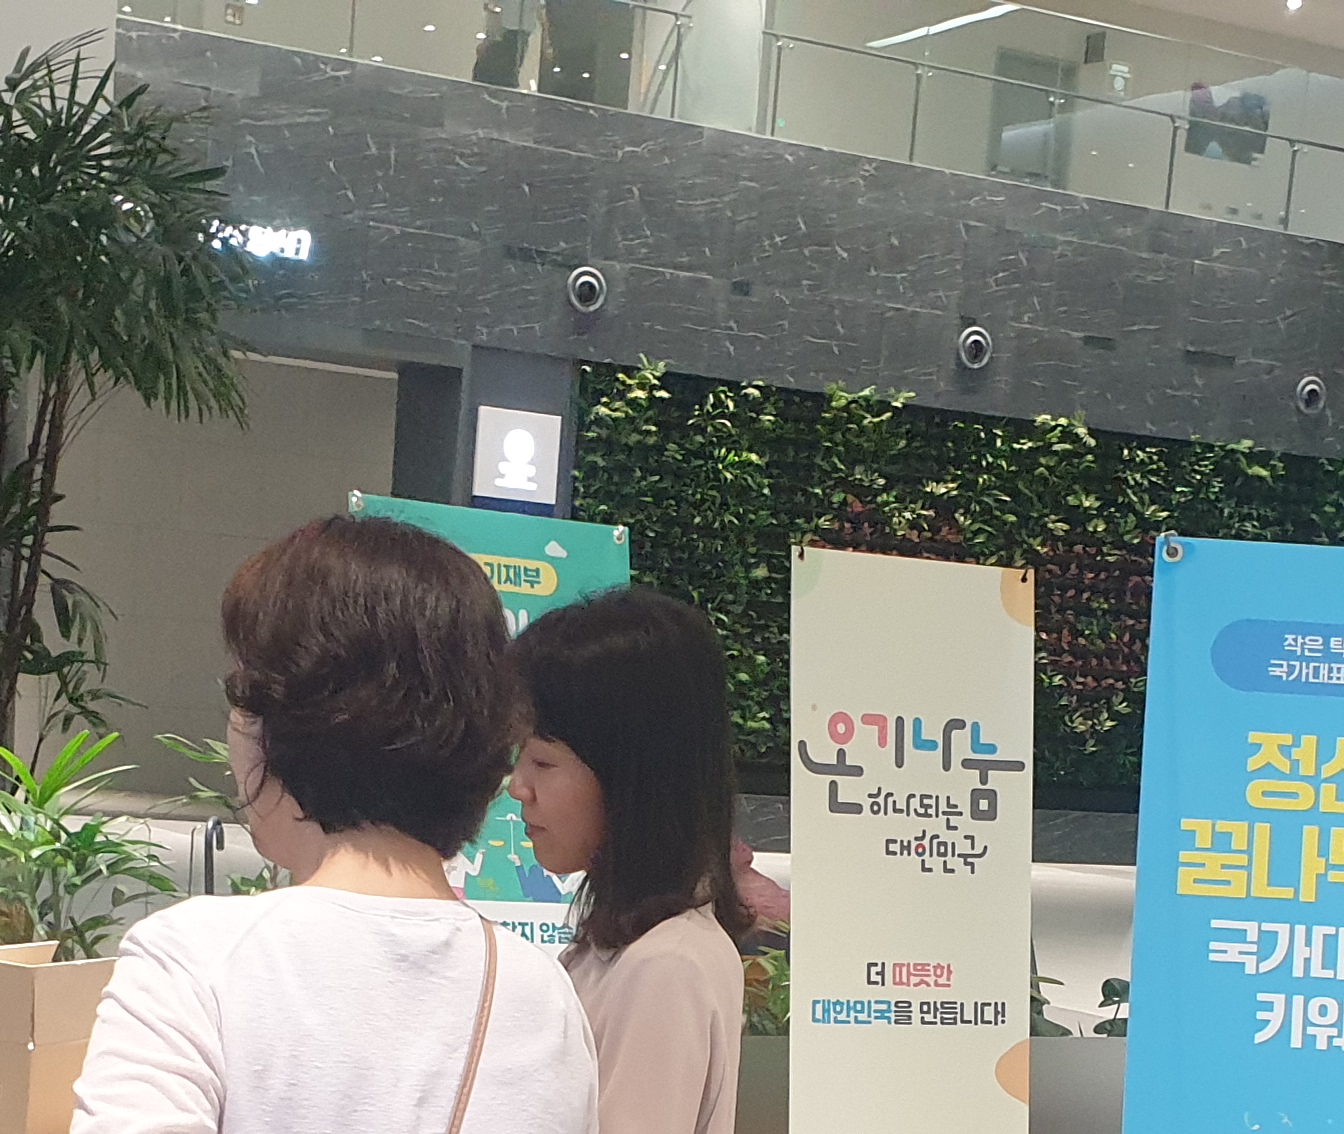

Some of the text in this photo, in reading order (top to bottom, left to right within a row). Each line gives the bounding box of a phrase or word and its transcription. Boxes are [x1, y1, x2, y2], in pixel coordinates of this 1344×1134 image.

[1283, 634, 1324, 656] 작은
[885, 829, 988, 875] 대한민국
[866, 962, 953, 988] 더 따뜻한
[811, 999, 1006, 1026] 대한민국을 만듭니다!
